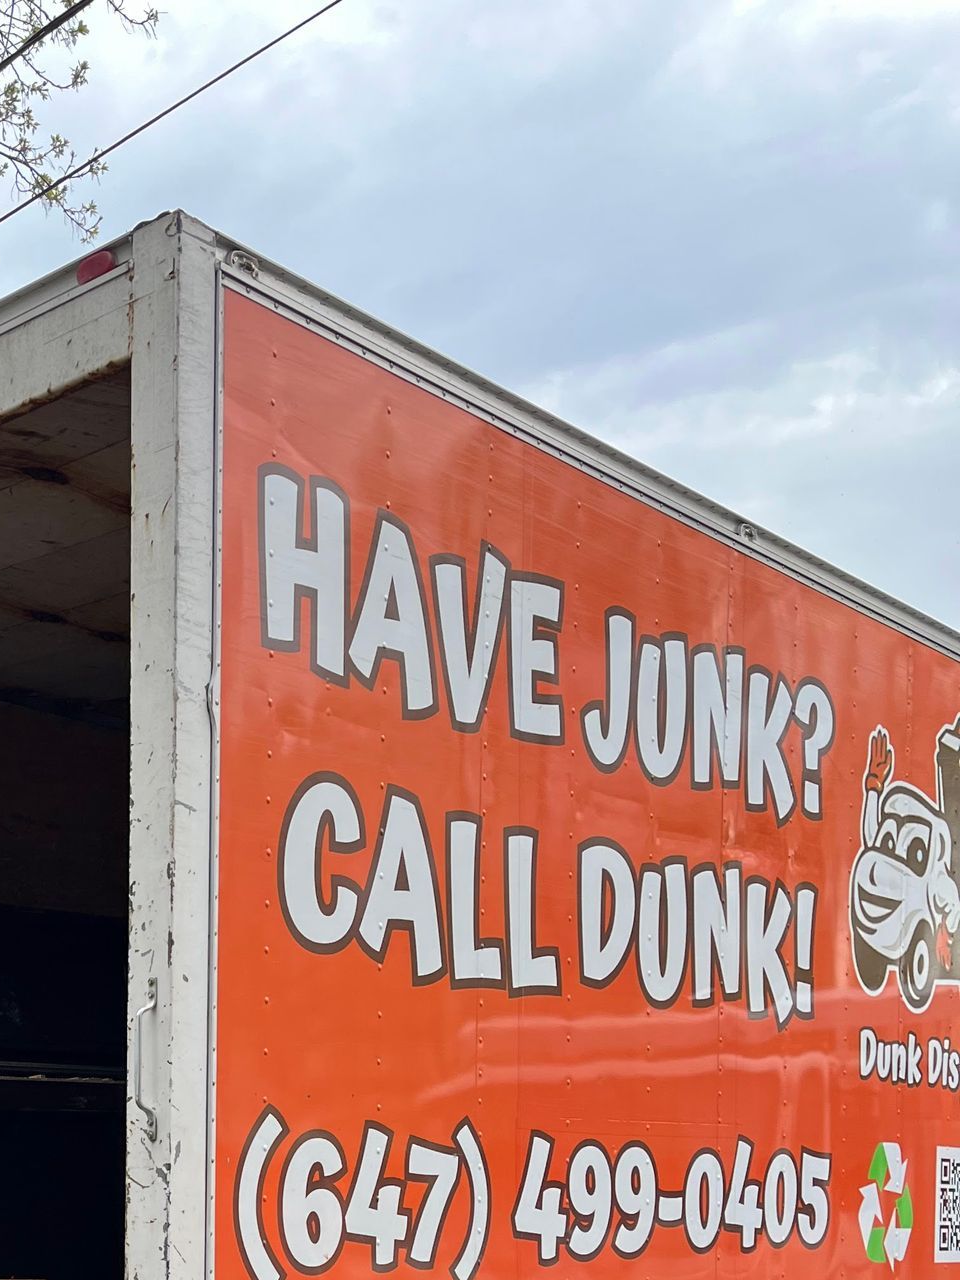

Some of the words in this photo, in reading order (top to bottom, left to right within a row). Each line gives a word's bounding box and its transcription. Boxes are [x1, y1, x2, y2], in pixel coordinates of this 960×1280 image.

[258, 464, 564, 744] HAVE
[580, 606, 835, 827] JUNK?
[279, 772, 562, 997] CALL
[578, 837, 816, 1031] DUNK!
[859, 1027, 923, 1088] Dunk
[512, 1129, 832, 1267] 499-0405
